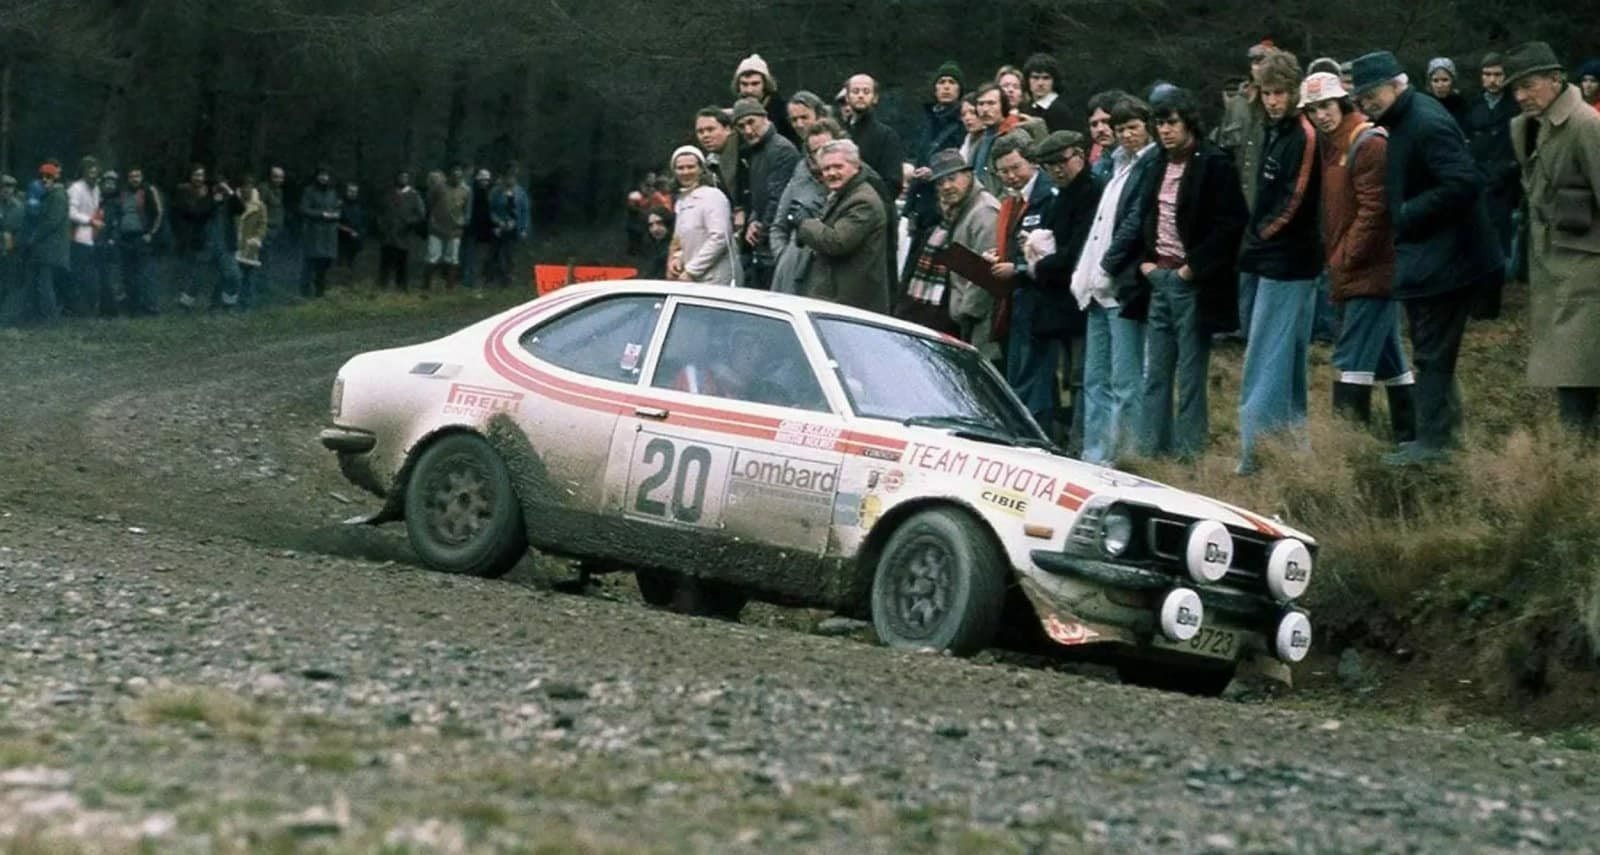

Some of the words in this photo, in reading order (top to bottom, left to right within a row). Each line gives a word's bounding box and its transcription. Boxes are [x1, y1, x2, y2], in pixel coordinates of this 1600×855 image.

[446, 383, 524, 413] PIRELLI
[635, 437, 712, 523] 20
[731, 451, 838, 492] Lombard
[908, 443, 969, 475] TEAM
[972, 456, 1057, 500] TOYOTA
